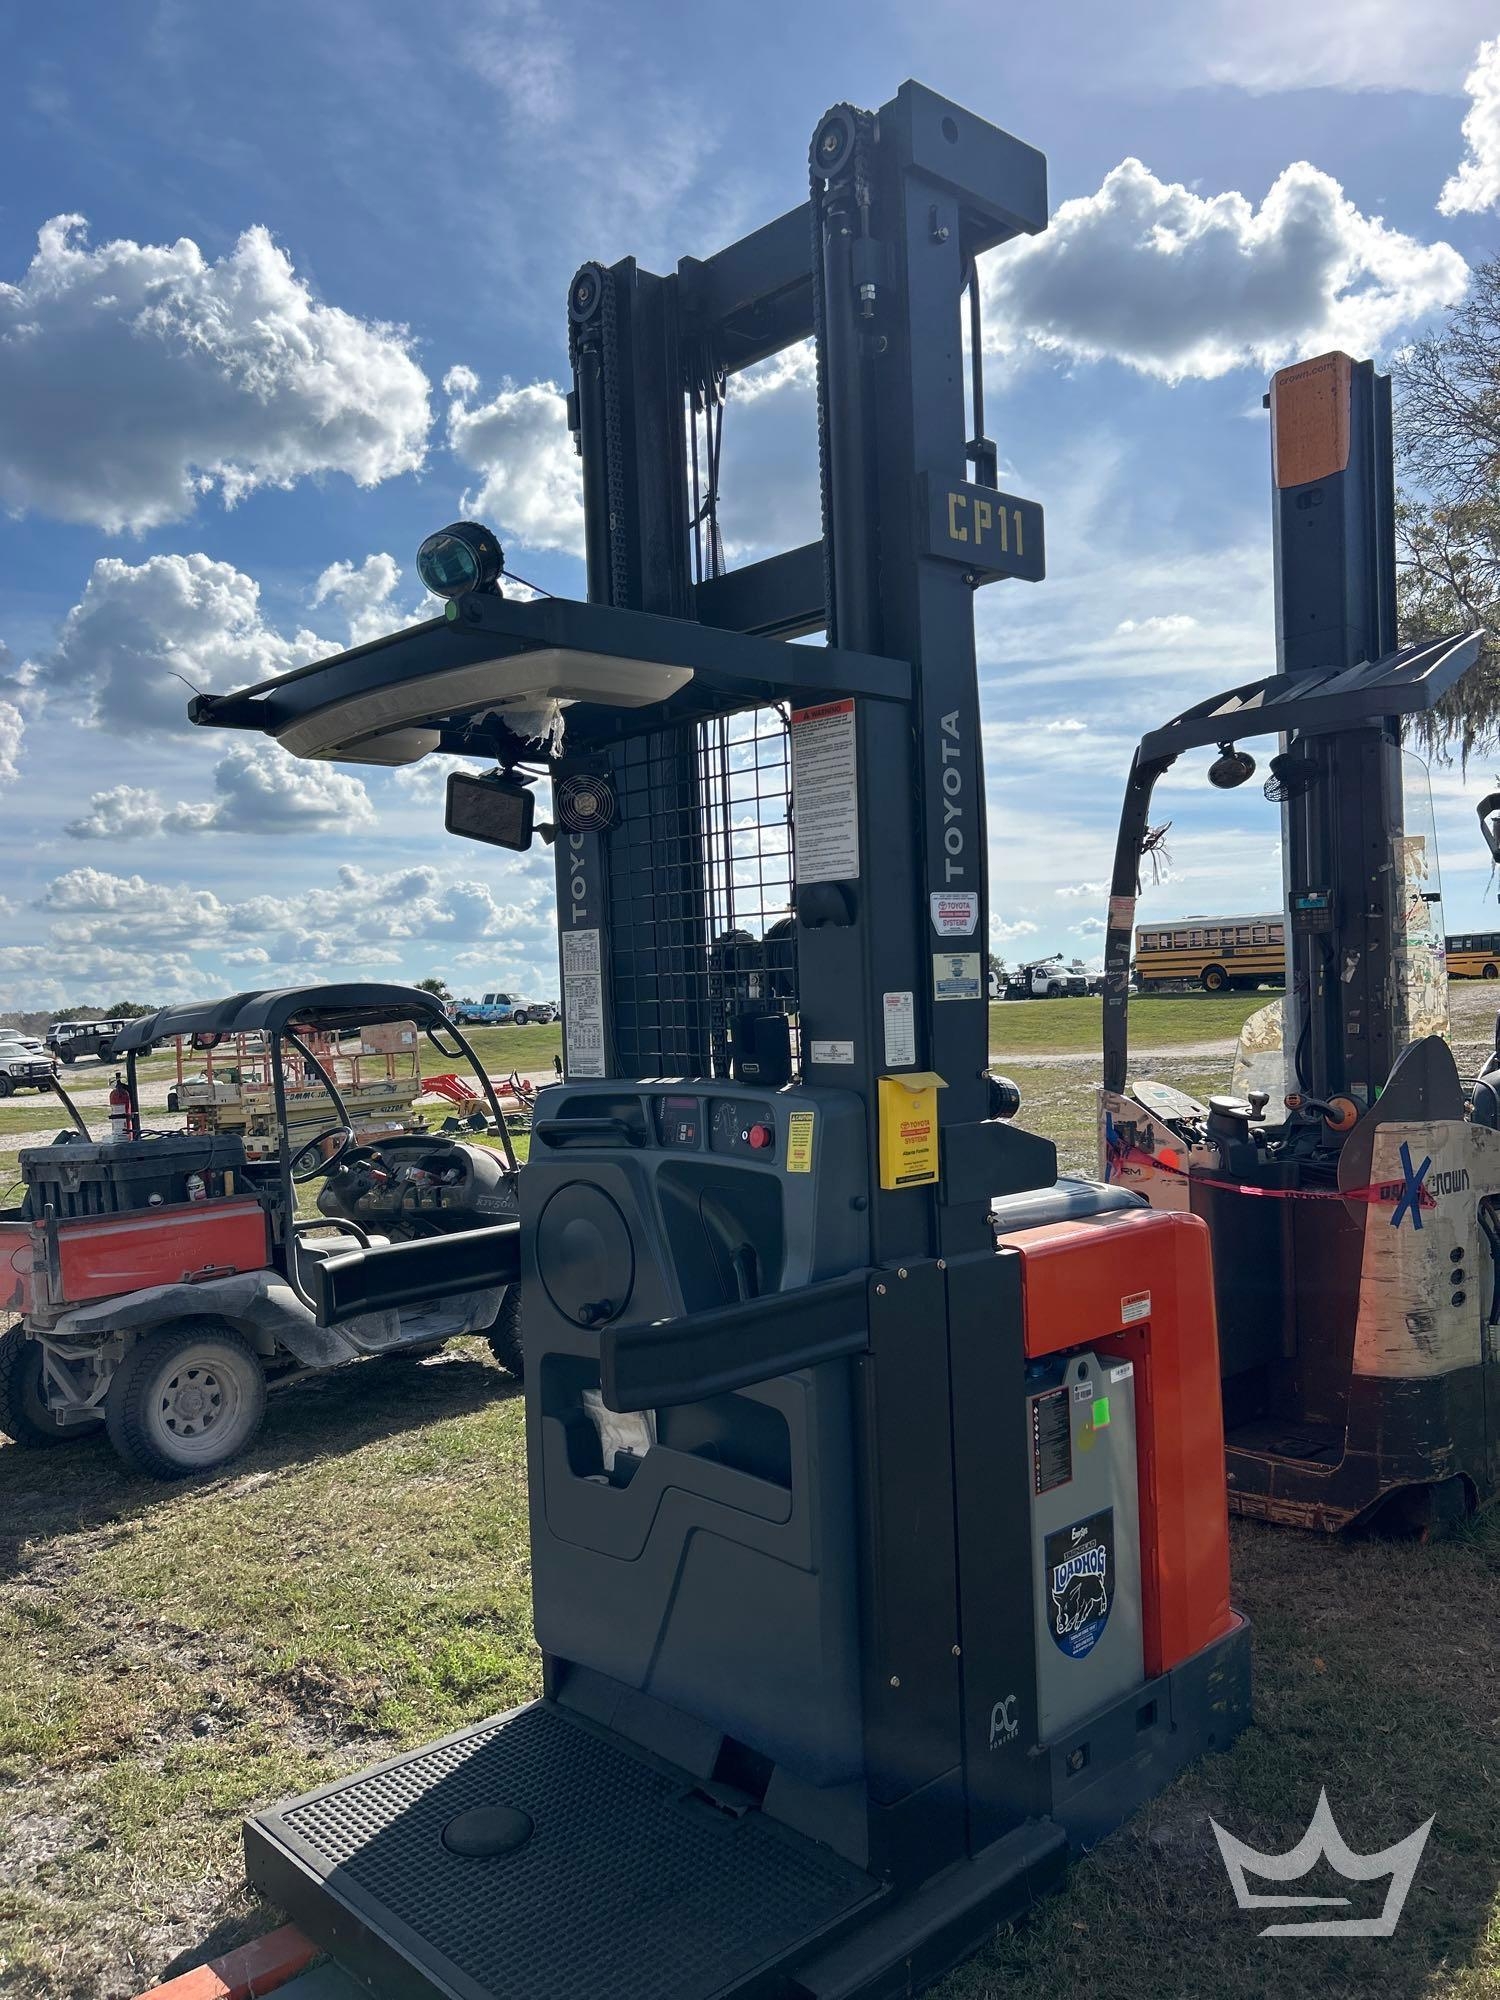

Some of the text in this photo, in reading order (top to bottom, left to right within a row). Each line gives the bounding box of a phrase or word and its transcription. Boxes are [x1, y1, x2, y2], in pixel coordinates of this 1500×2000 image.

[948, 492, 1023, 556] CP11
[941, 710, 964, 882] TOYOTA
[569, 833, 587, 924] TOYO
[947, 902, 970, 910] TOYOTA
[943, 919, 968, 927] SYSTEMS
[1053, 1545, 1107, 1593] LOADHOG
